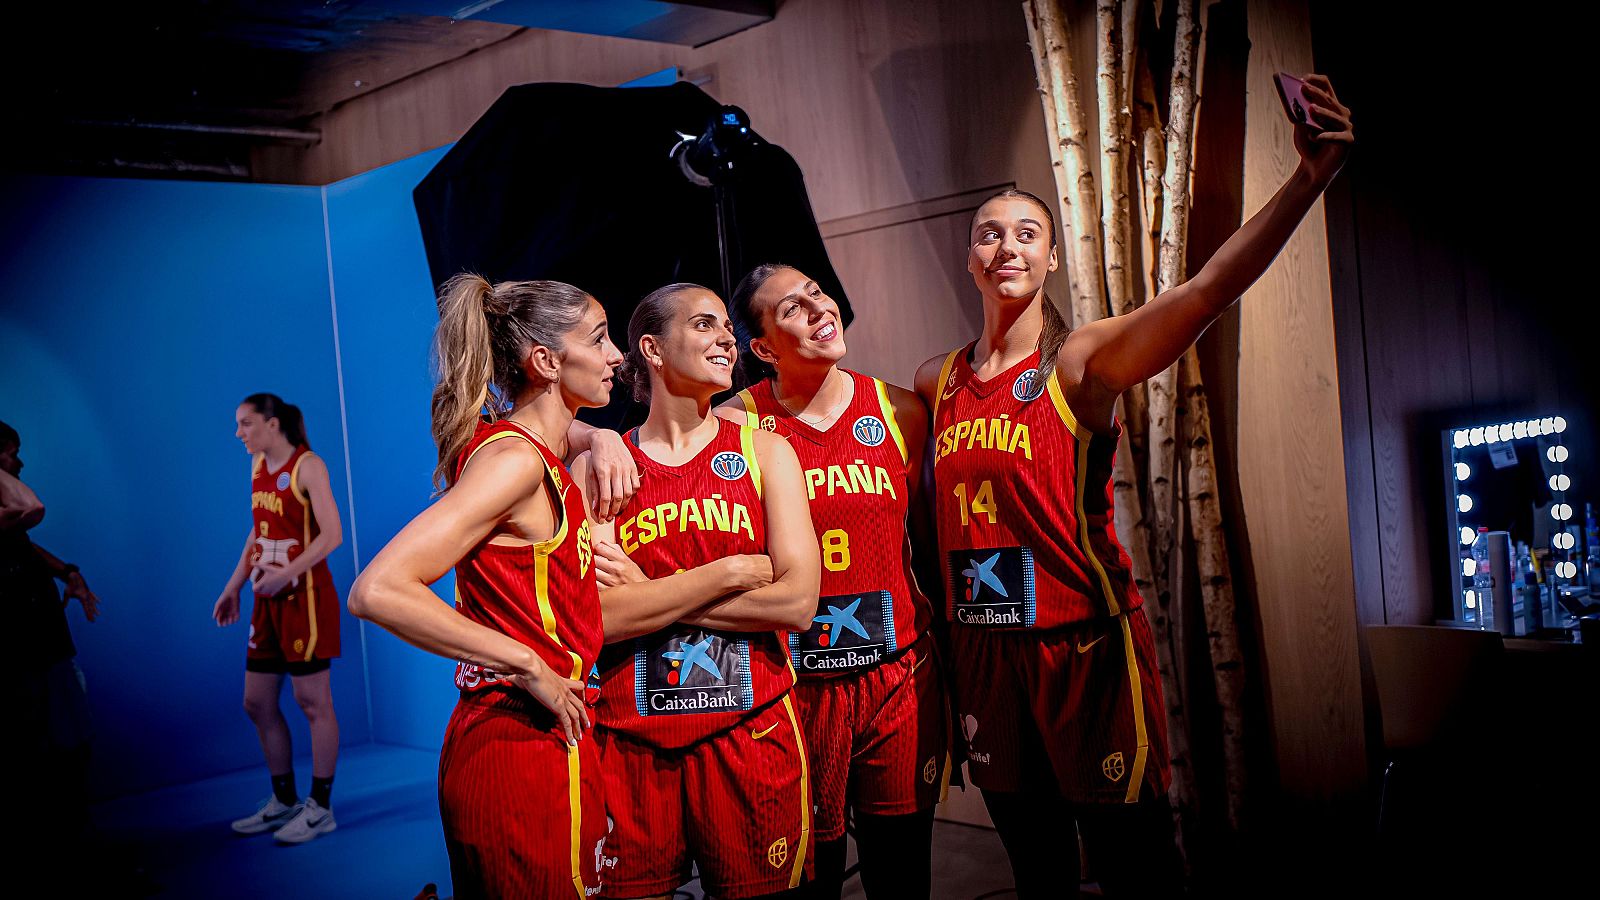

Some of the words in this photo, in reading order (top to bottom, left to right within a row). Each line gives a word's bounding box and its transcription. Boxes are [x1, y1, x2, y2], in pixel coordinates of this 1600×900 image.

[934, 413, 1033, 467] ESPAÑA
[804, 458, 897, 500] PAÑA
[619, 493, 755, 556] ESPAÑA
[953, 480, 997, 526] 14
[822, 528, 851, 572] 8
[957, 607, 1021, 624] CaixaBank
[803, 648, 882, 670] CaixaBank
[650, 690, 738, 711] CaixaBank
